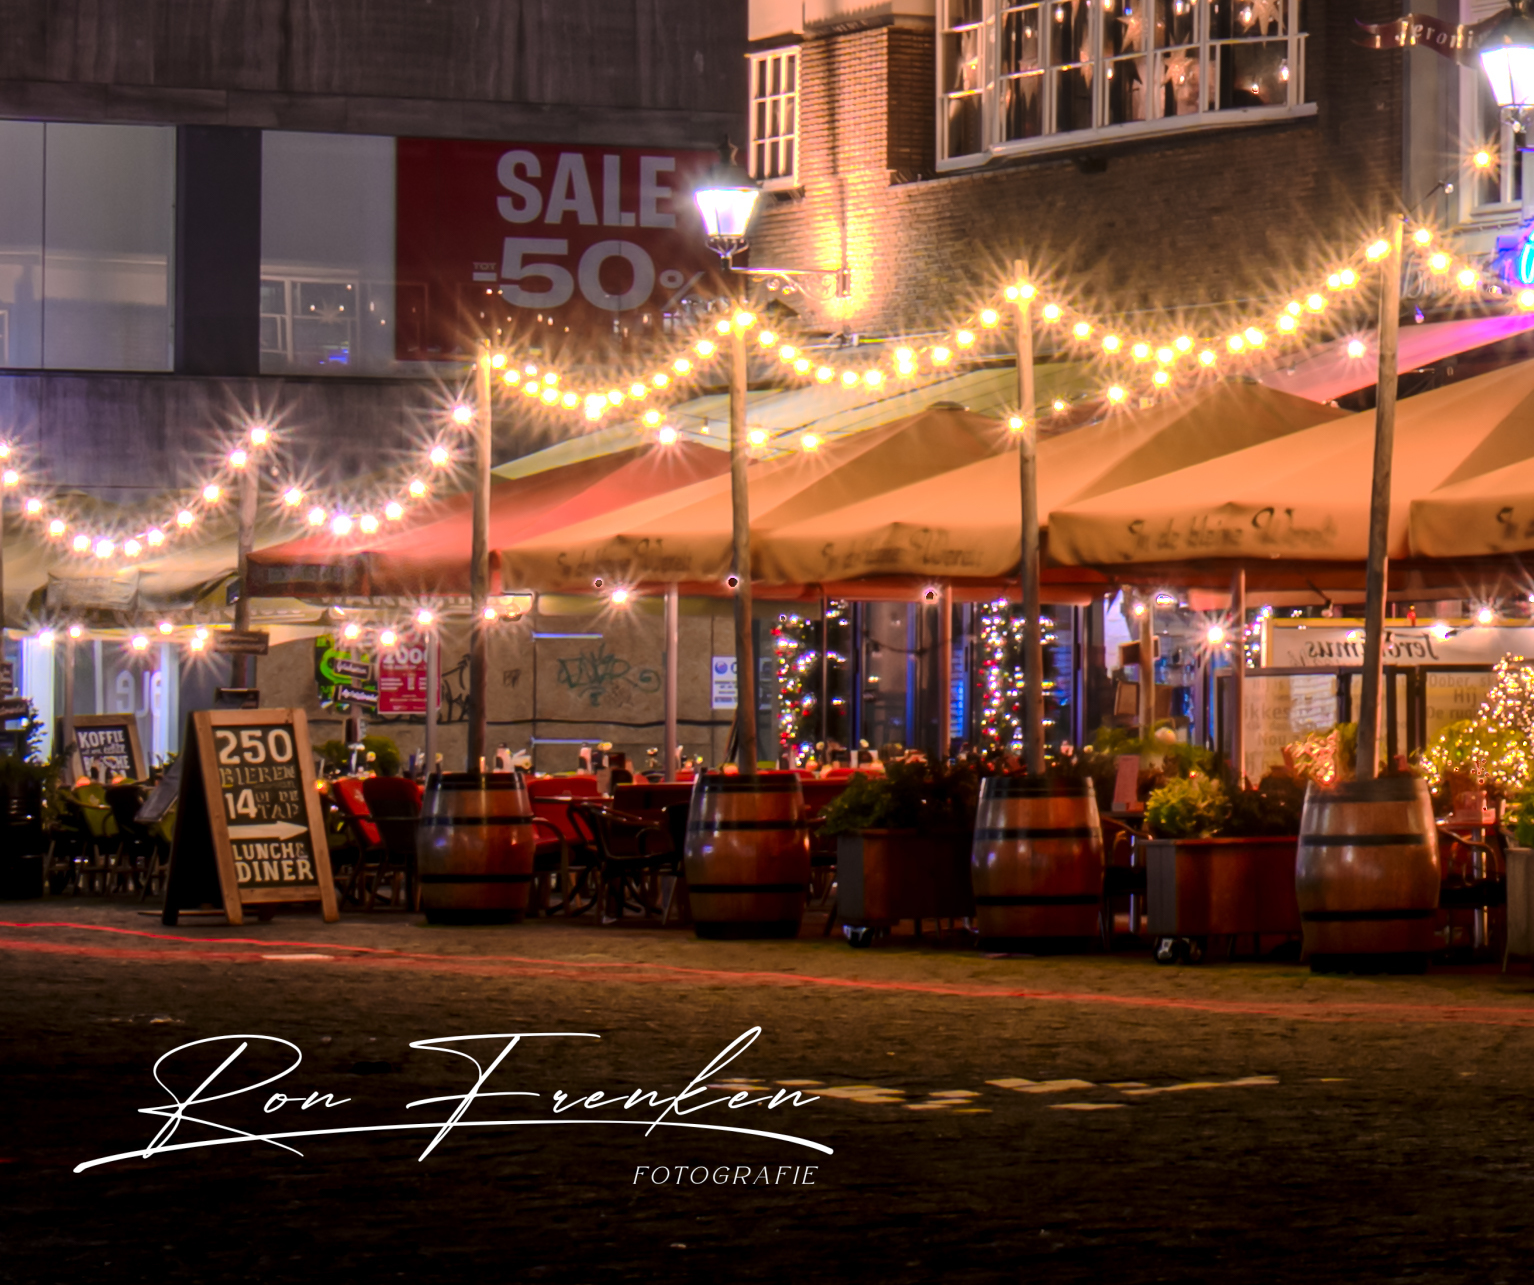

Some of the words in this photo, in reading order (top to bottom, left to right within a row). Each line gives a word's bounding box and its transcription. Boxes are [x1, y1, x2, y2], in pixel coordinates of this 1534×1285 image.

[496, 149, 676, 229] SALE
[77, 730, 125, 749] KOFFIE
[215, 729, 294, 766] 250
[219, 765, 296, 789] BIEREN
[225, 788, 257, 820] 14
[234, 858, 315, 883] DINER
